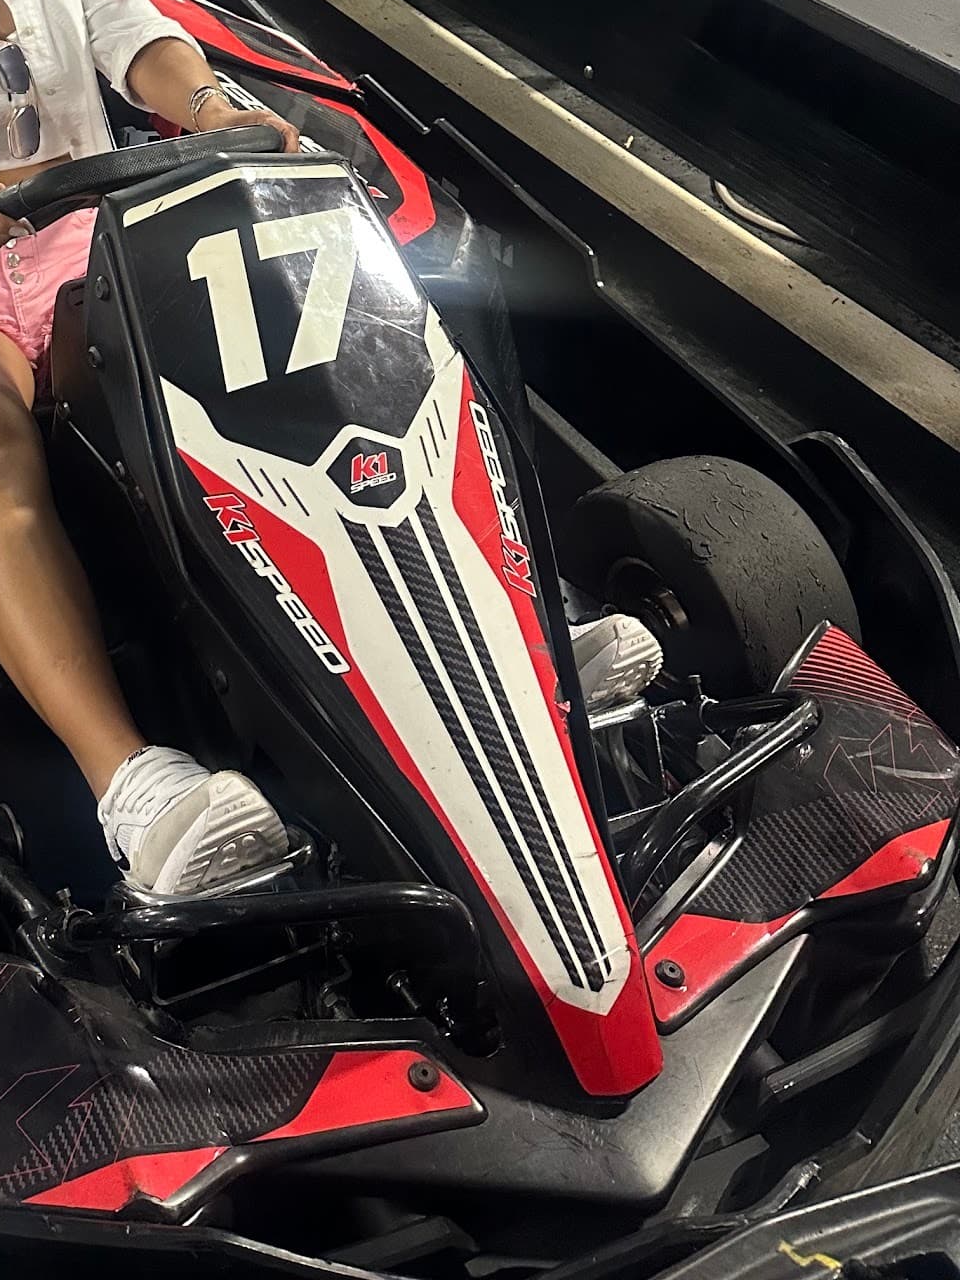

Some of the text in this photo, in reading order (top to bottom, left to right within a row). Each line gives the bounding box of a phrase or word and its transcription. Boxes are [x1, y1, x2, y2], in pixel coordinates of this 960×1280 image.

[186, 207, 359, 393] 17
[350, 451, 389, 482] K1
[350, 472, 397, 495] SPEED
